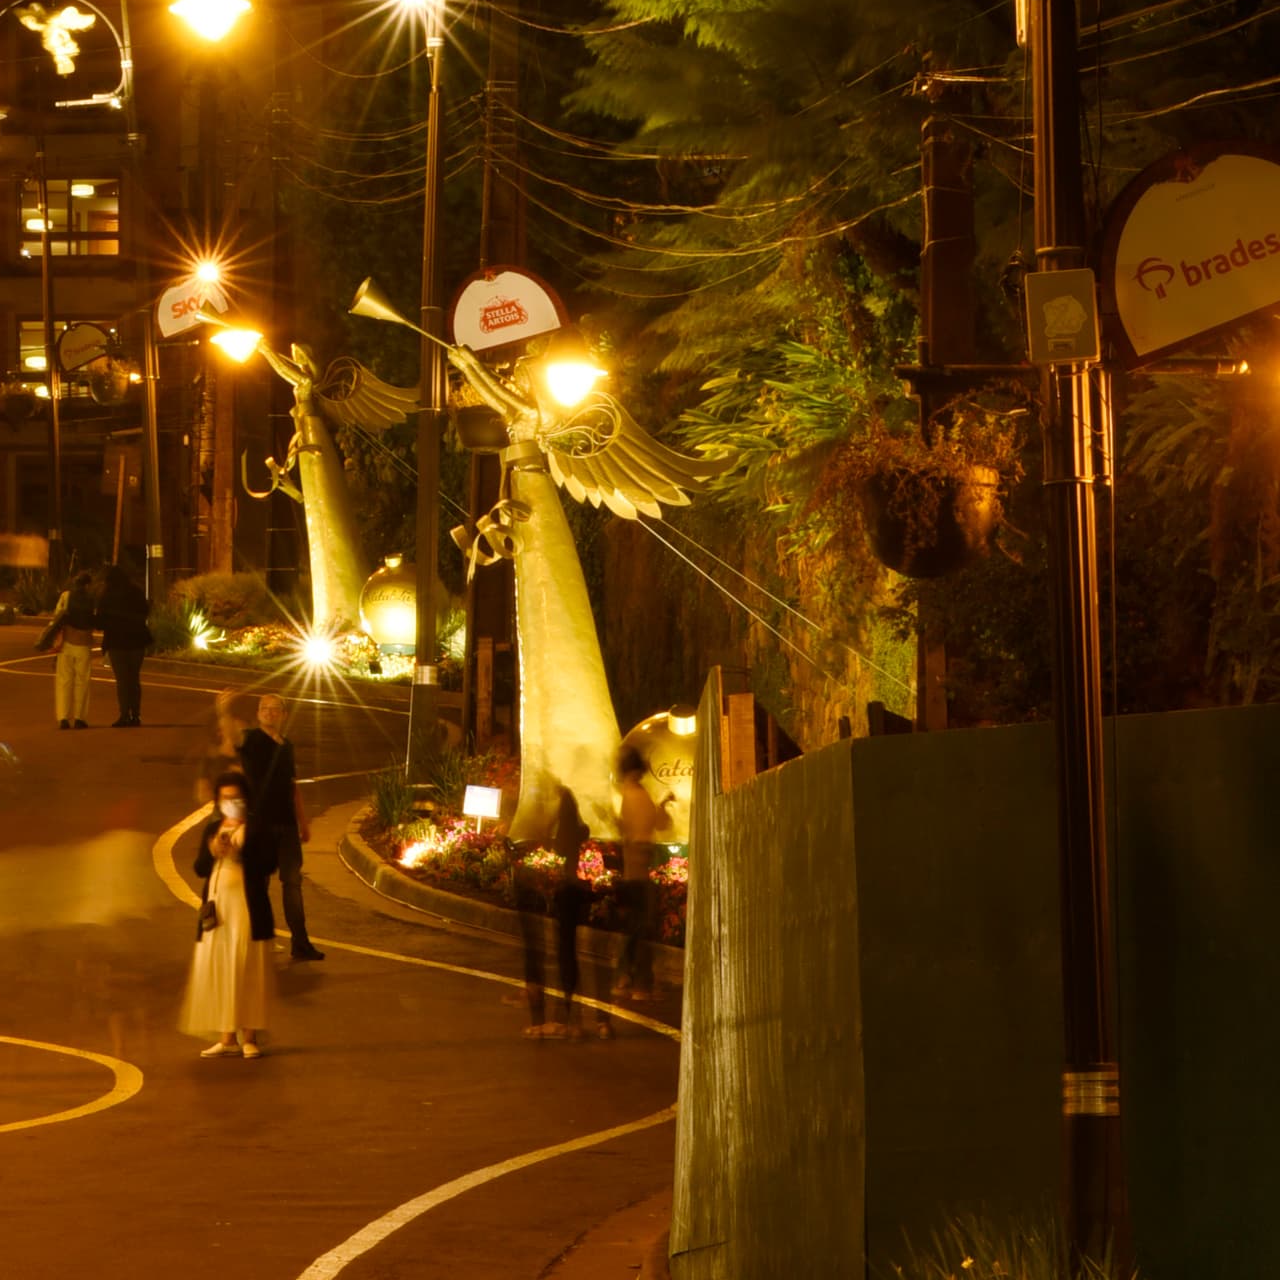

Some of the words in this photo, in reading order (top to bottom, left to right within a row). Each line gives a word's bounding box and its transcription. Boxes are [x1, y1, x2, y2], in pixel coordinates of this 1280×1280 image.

[1180, 233, 1280, 287] brades
[485, 305, 518, 319] STELLA
[487, 313, 520, 327] ARTOIS
